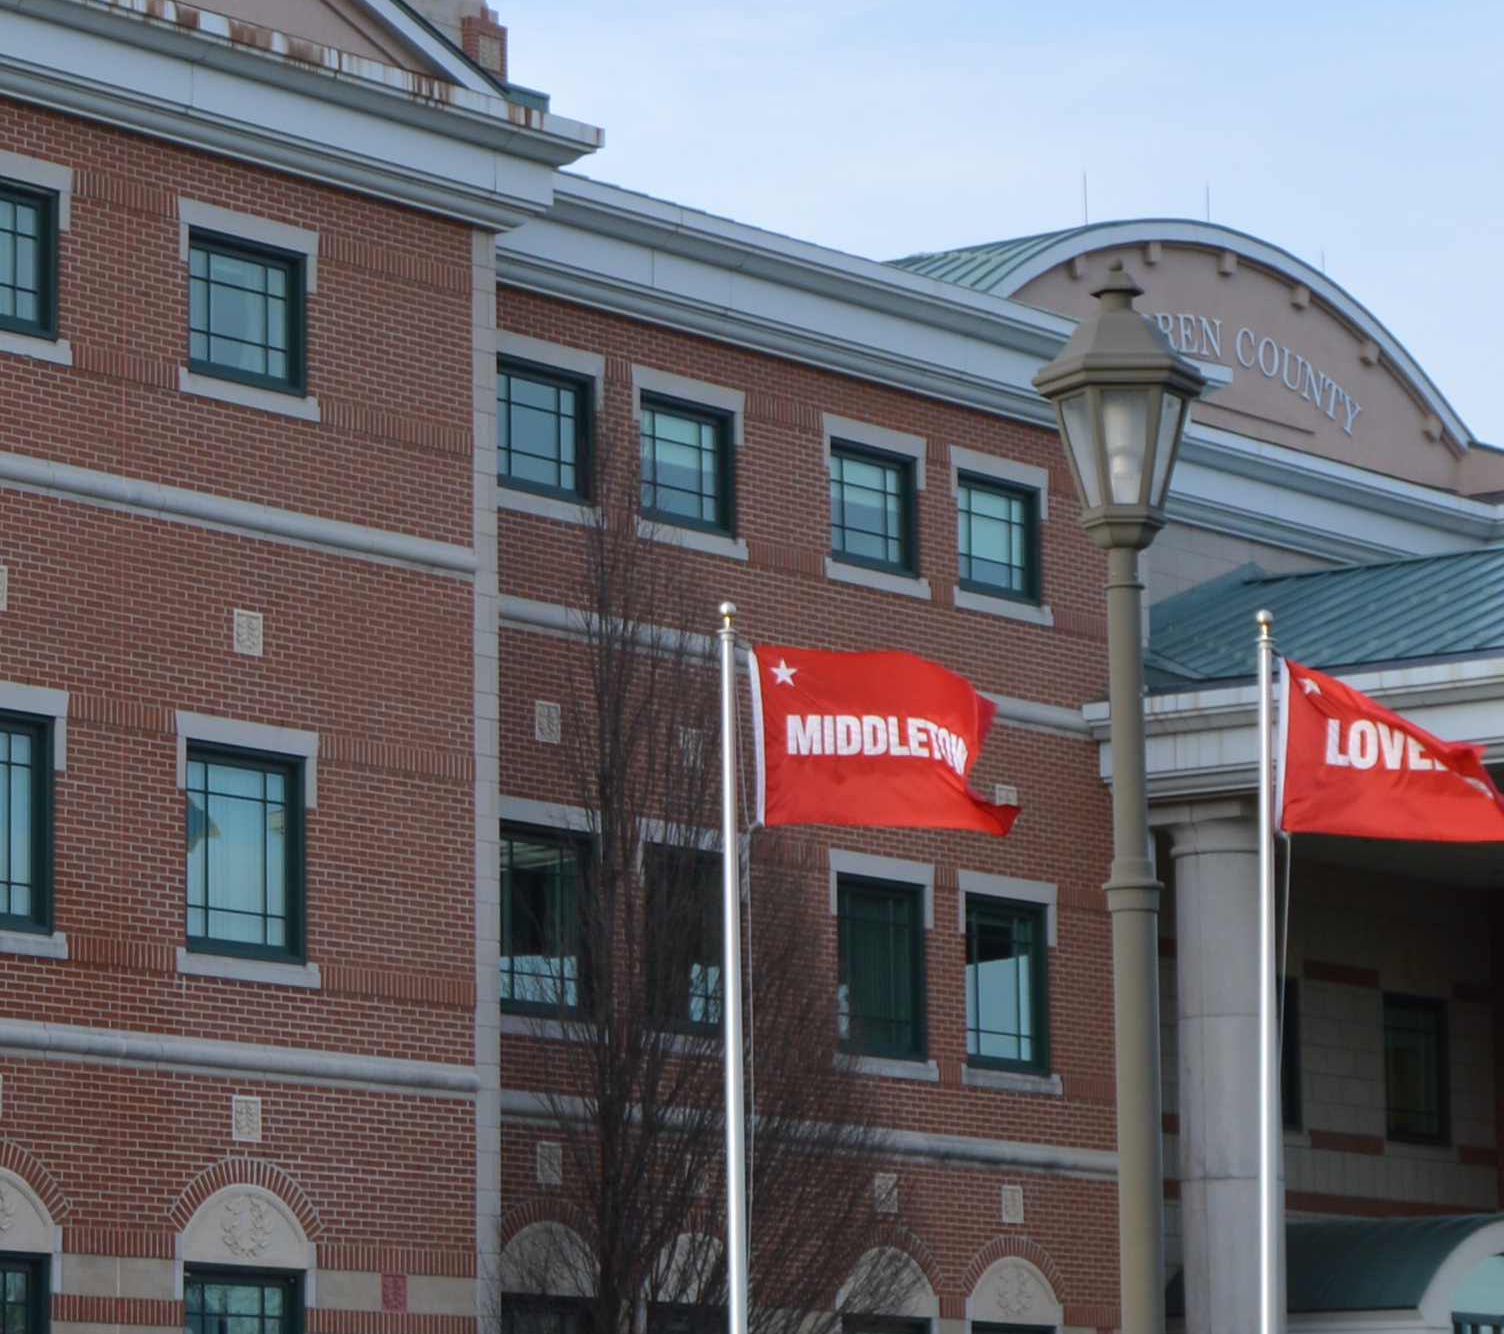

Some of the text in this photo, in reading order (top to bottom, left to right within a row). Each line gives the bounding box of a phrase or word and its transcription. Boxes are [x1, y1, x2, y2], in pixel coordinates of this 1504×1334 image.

[1153, 312, 1363, 437] REN COUNTY
[1325, 717, 1450, 772] LOVE
